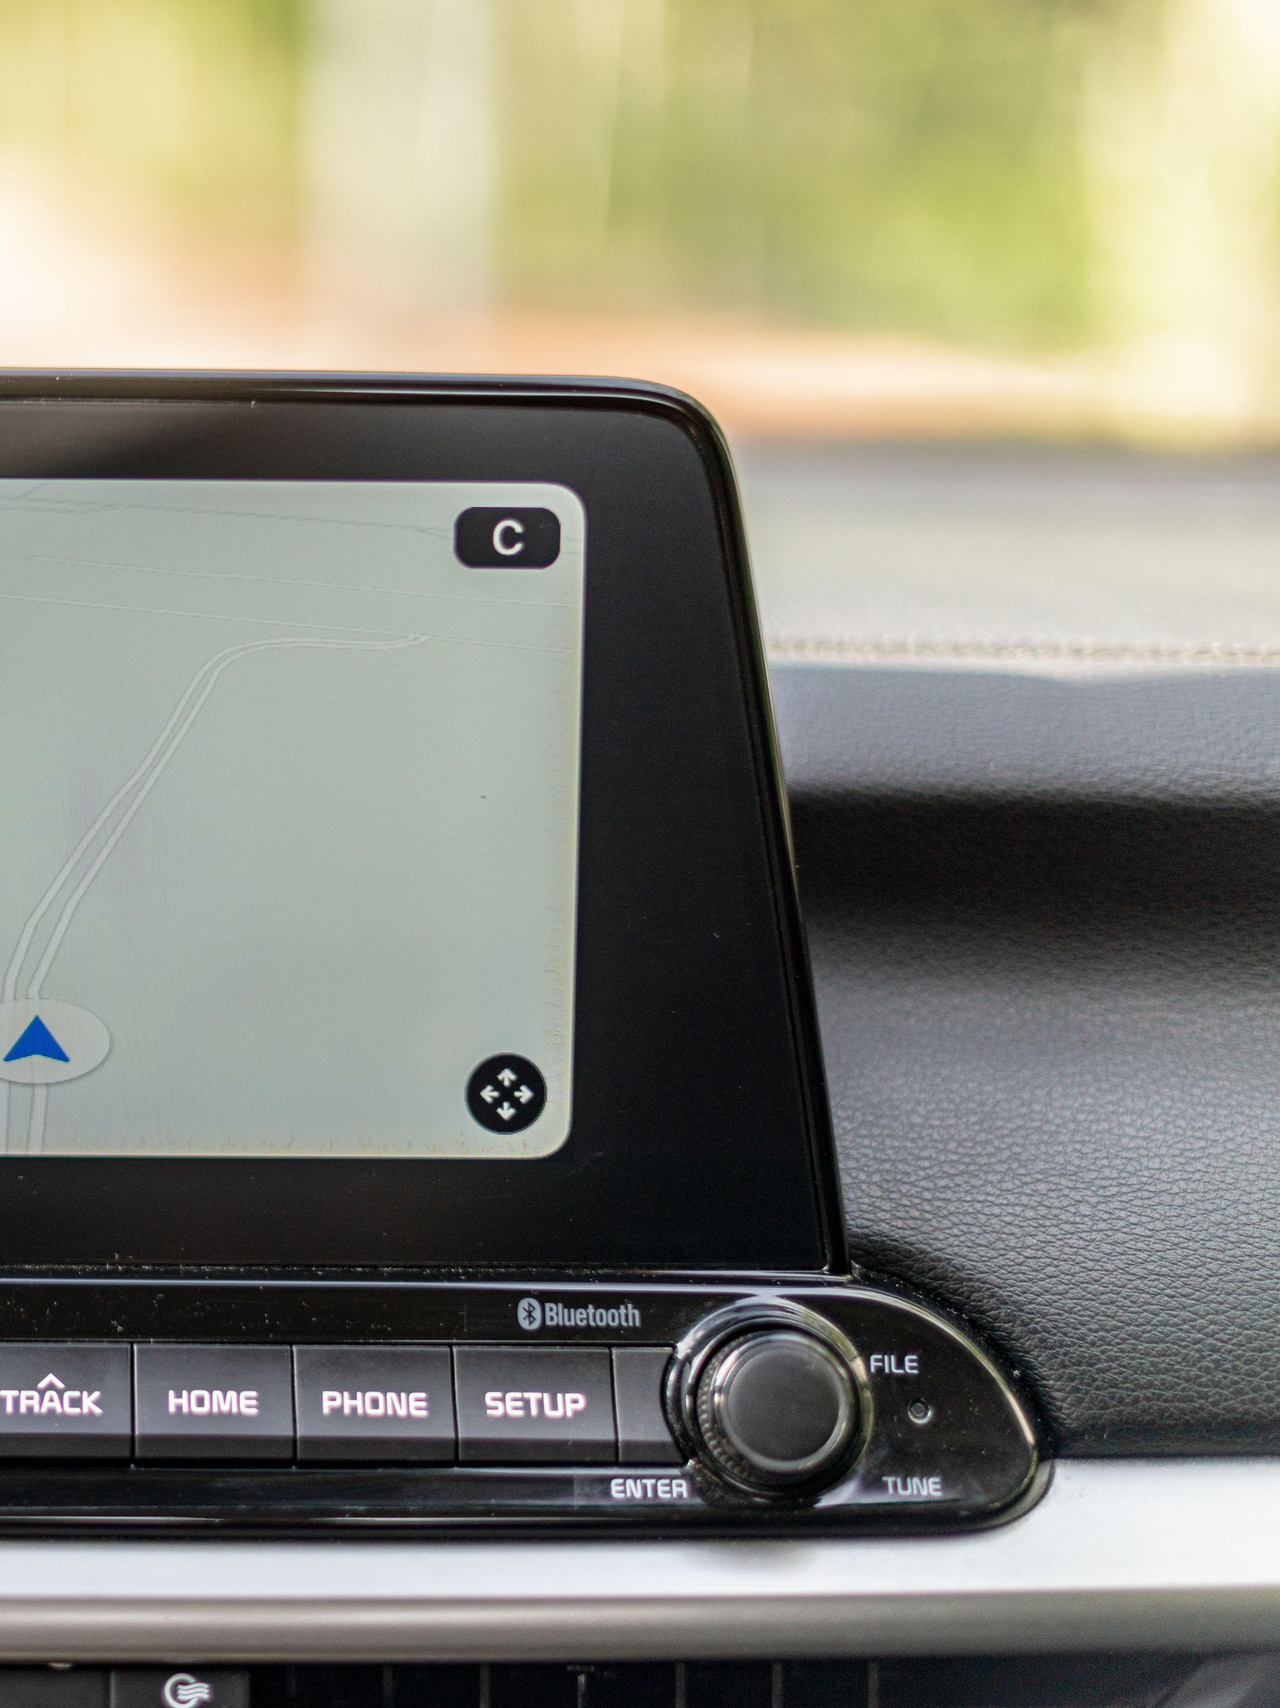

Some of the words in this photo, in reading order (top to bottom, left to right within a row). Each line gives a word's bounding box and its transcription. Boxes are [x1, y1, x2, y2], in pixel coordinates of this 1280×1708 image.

[493, 519, 524, 556] C
[544, 1302, 640, 1327] Bluetooth
[869, 1354, 918, 1374] FILE
[0, 1389, 102, 1415] TRACK
[167, 1390, 259, 1415] HOME
[321, 1391, 429, 1417] PHONE
[484, 1391, 587, 1418] SETUP
[610, 1479, 688, 1499] ENTER
[883, 1477, 942, 1496] TUNE
